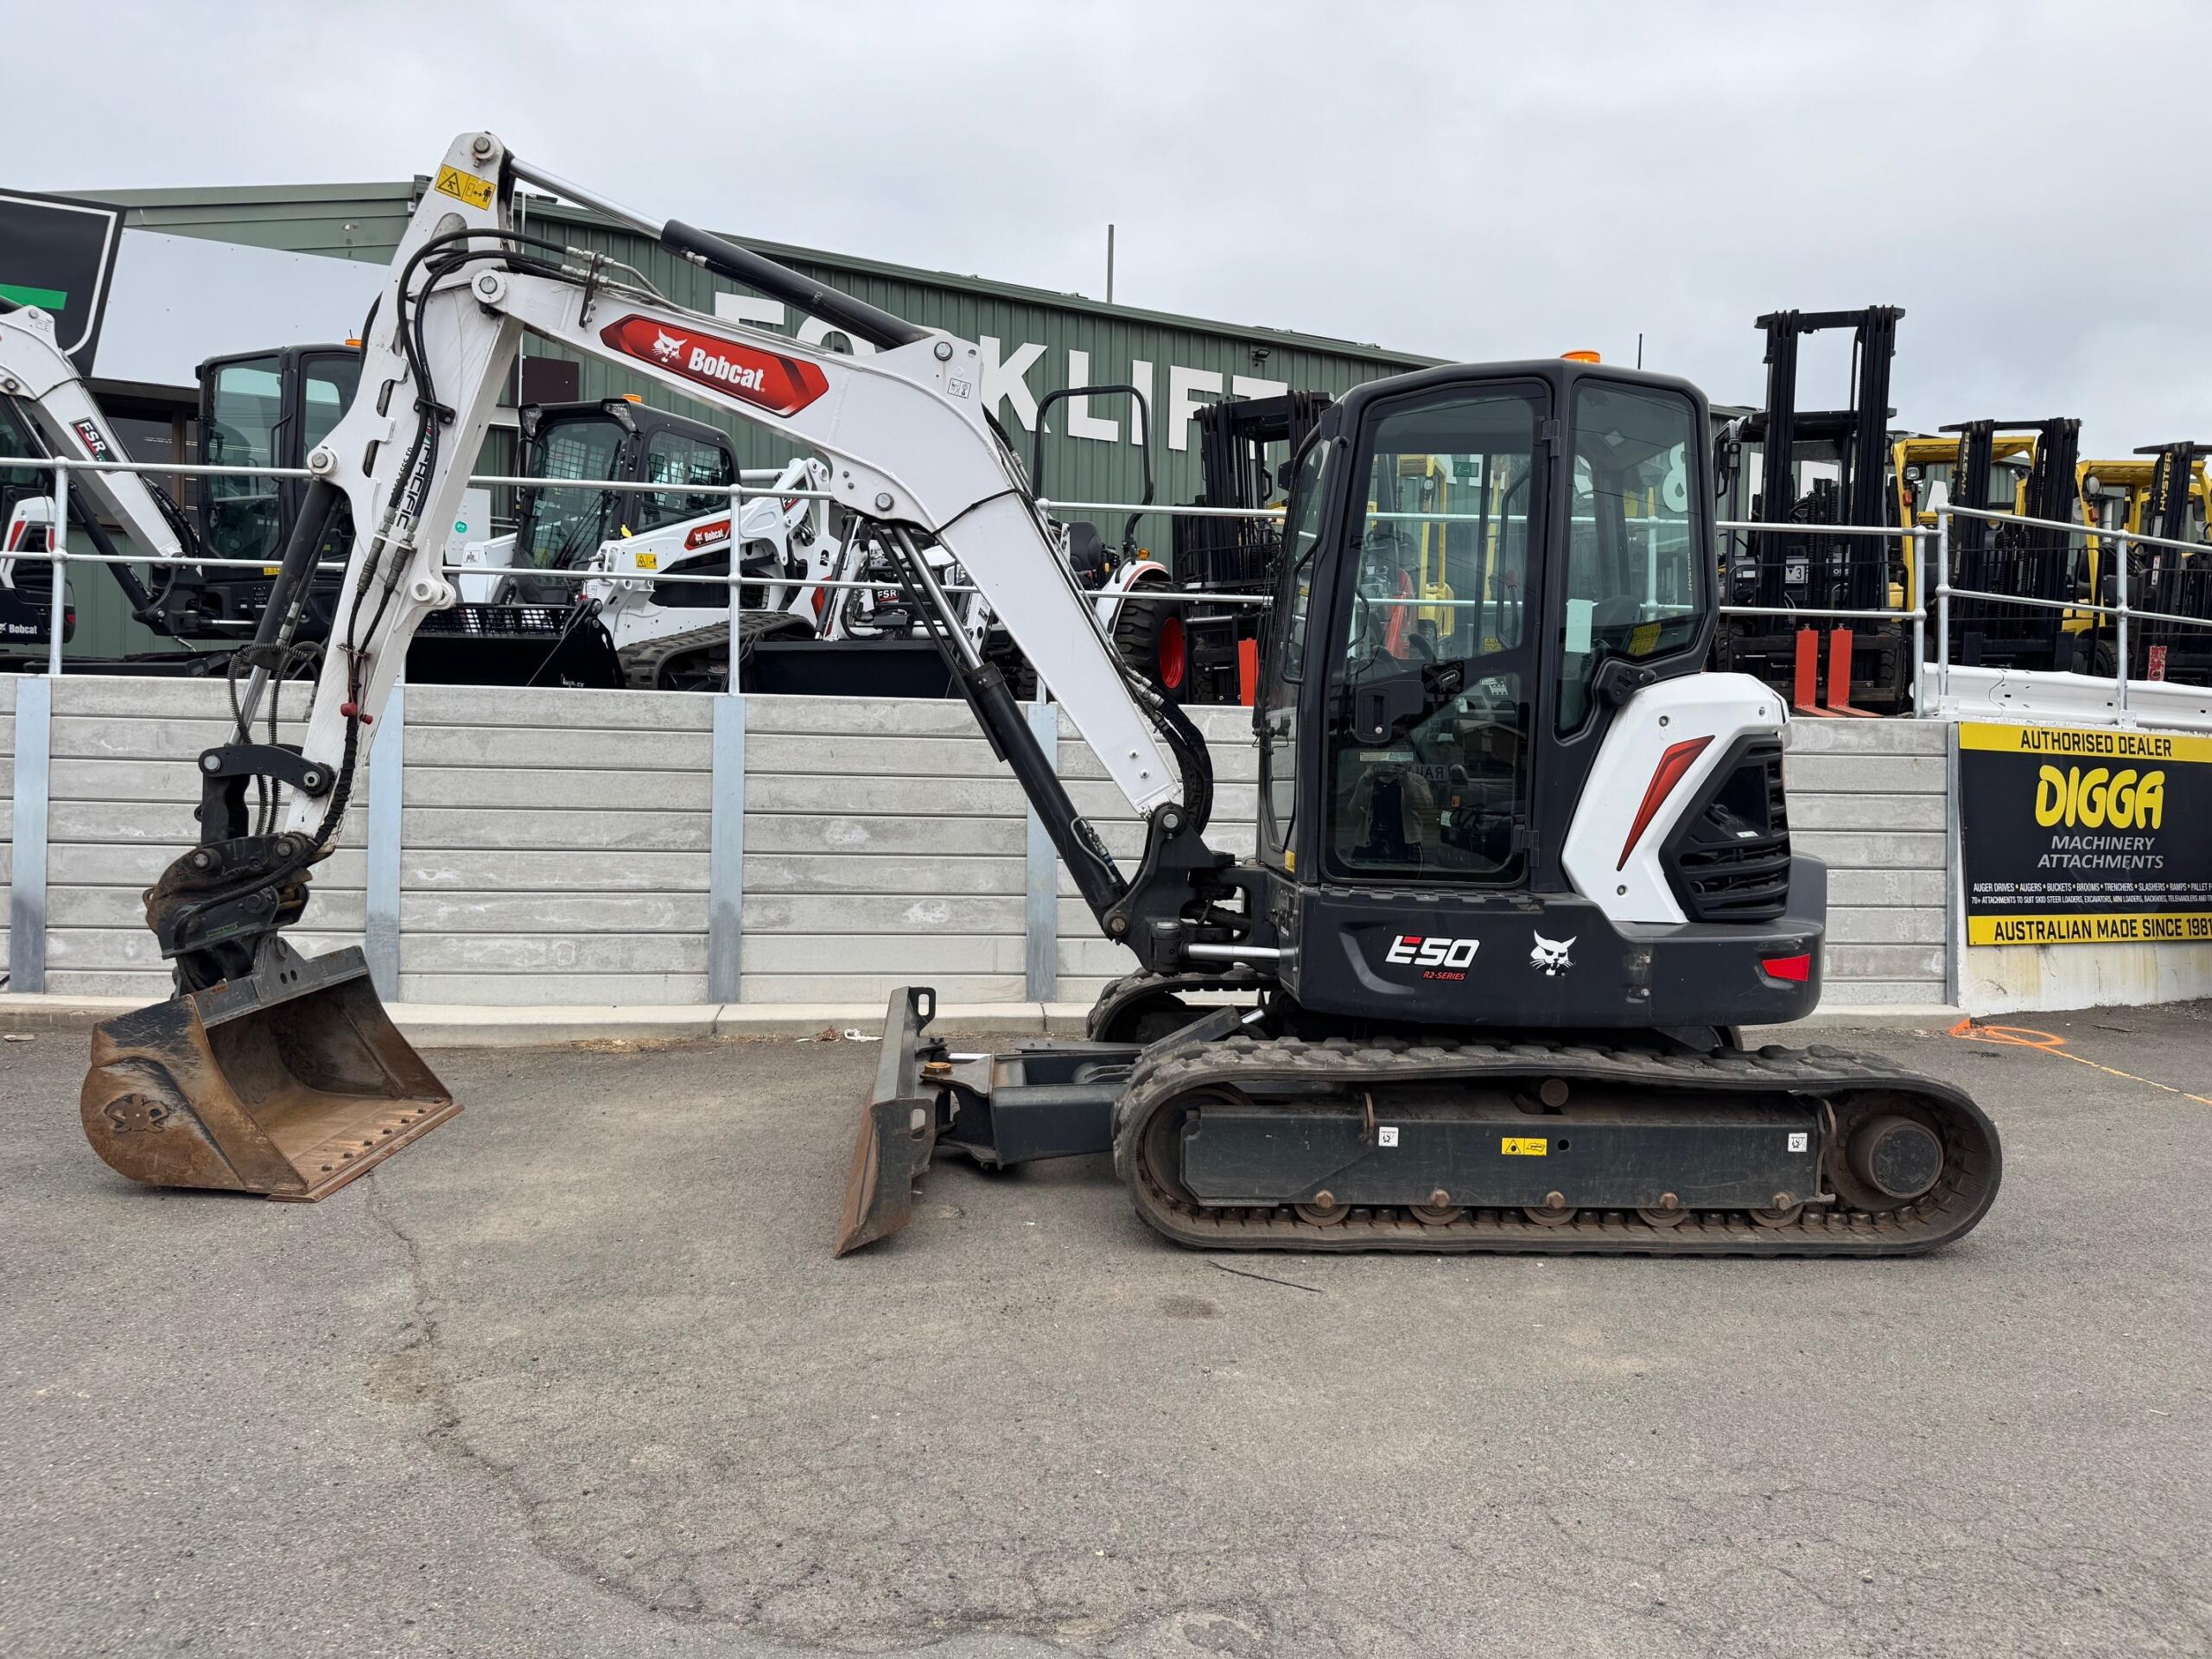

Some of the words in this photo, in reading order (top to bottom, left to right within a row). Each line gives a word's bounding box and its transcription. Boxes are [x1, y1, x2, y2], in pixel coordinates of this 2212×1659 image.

[688, 347, 765, 391] Bobcat
[715, 291, 1288, 461] KLIFT
[78, 422, 106, 453] FSR
[2159, 452, 2172, 512] HYSTER
[704, 528, 724, 542] Bobcat
[877, 589, 897, 599] FSR
[9, 624, 37, 635] Bobcat
[2020, 729, 2113, 753] AUTHORISED
[2119, 735, 2172, 757] DEALER
[2035, 765, 2165, 830] DIGGA
[2051, 835, 2155, 850] MACHINERY
[2037, 854, 2164, 869] ATTACHMENTS
[1974, 883, 1993, 893] AUGER
[1994, 883, 2014, 893] DRIVES
[2019, 882, 2042, 892] AUGERS
[2047, 882, 2072, 892] BUCKETS
[2076, 882, 2100, 892] BROOMS
[2104, 882, 2133, 892] TRENCHERS
[2139, 882, 2165, 892] SLASHERS
[2170, 882, 2187, 891] RAMPS
[2190, 882, 2208, 891] PALLET
[2047, 895, 2062, 904] STEER
[1994, 920, 2092, 941] AUSTRALIAN
[2097, 919, 2138, 938] MADE
[2143, 918, 2183, 938] SINCE
[2186, 918, 2212, 936] 1981
[1385, 935, 1480, 968] E50
[1423, 970, 1466, 981] R2-SERIES
